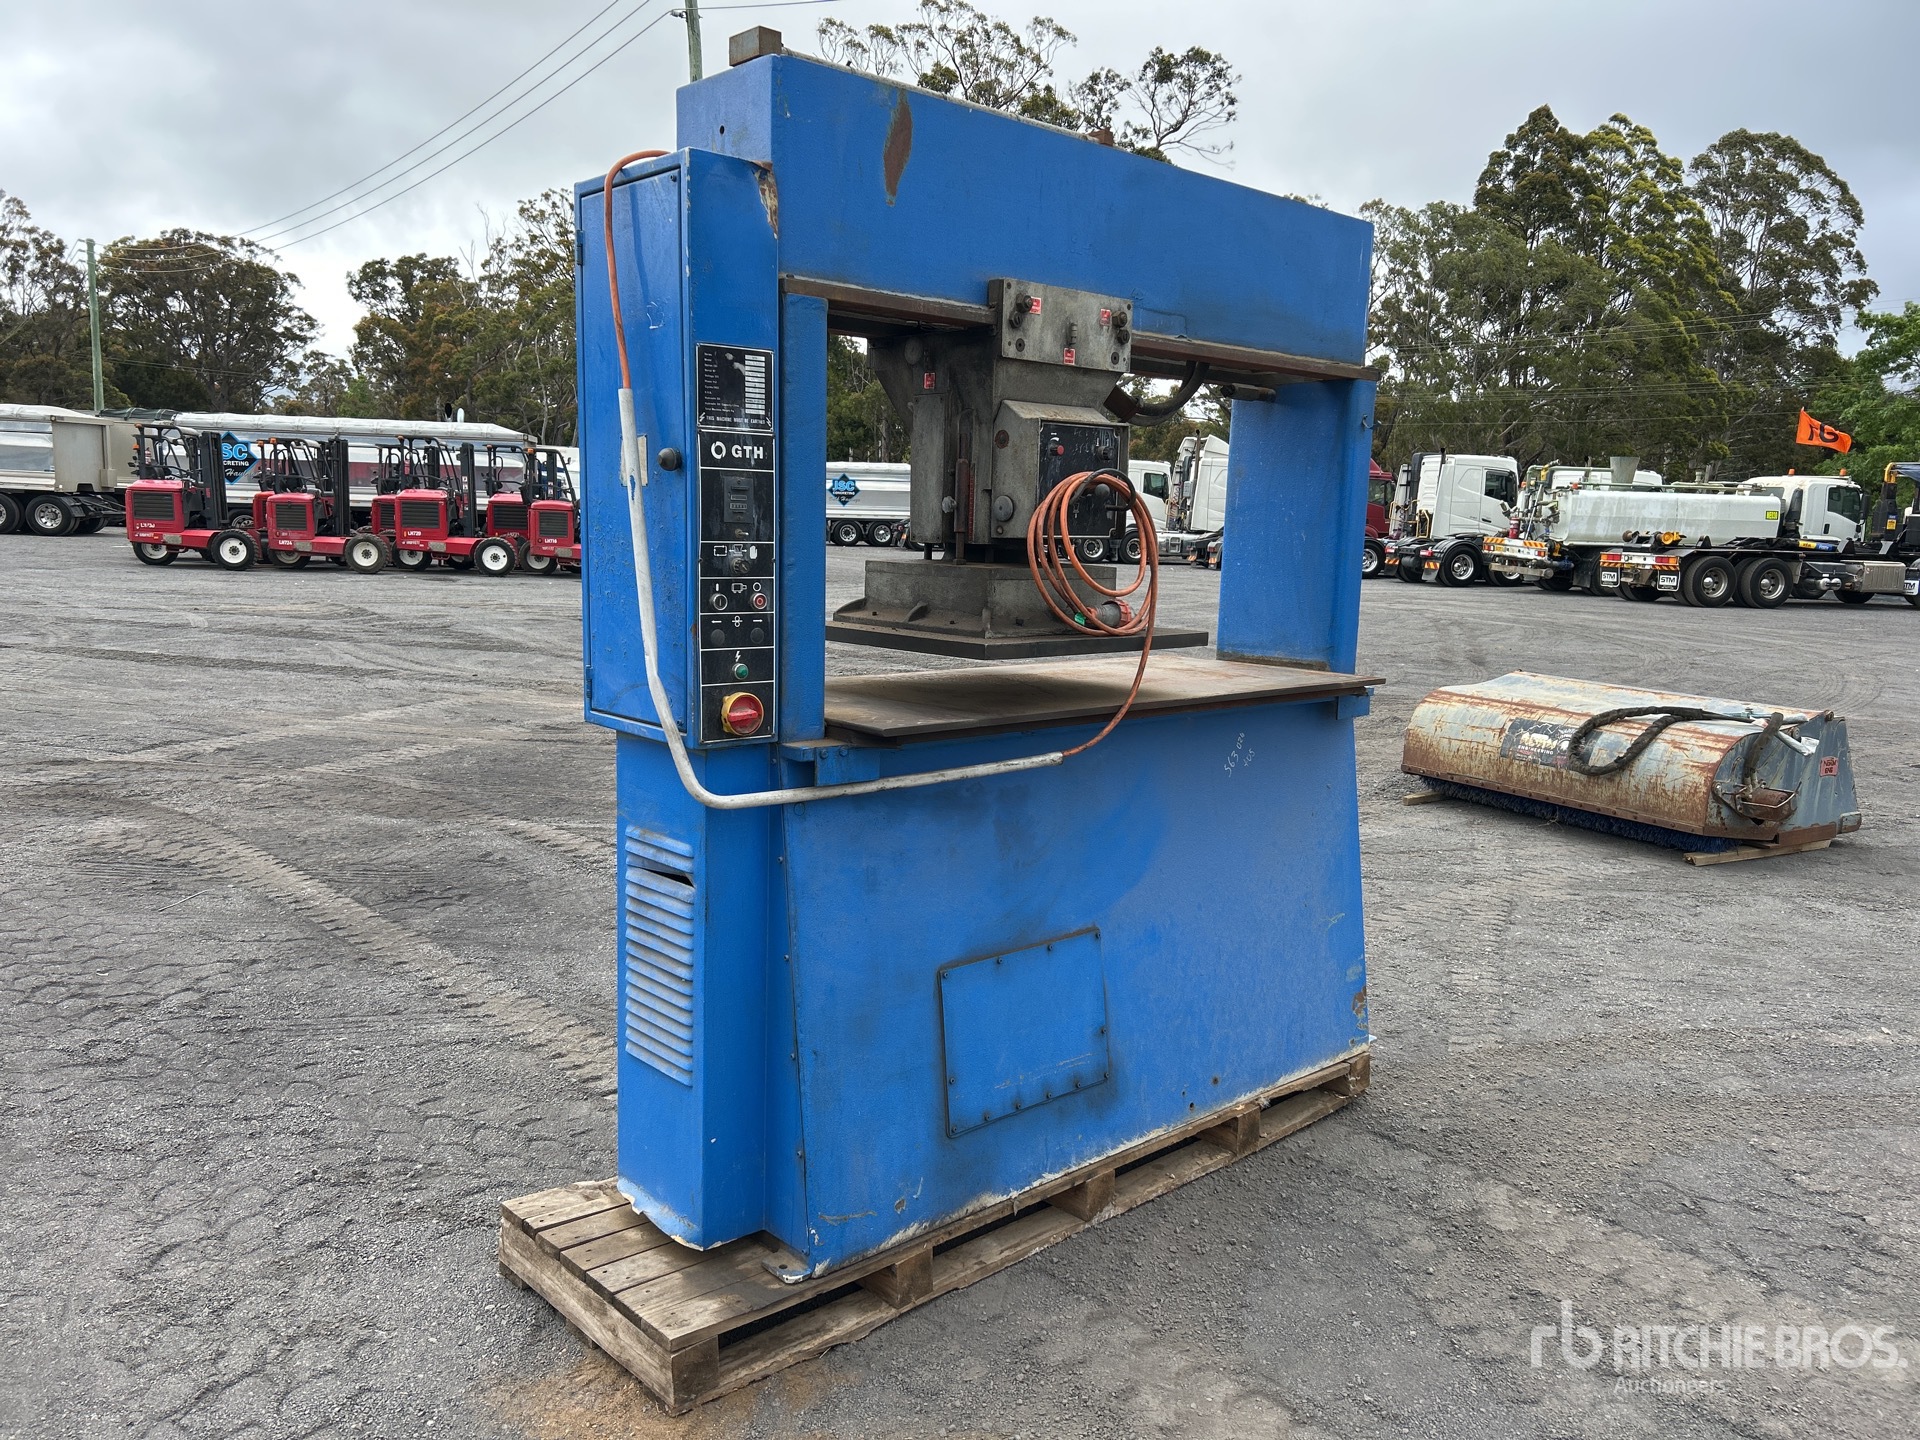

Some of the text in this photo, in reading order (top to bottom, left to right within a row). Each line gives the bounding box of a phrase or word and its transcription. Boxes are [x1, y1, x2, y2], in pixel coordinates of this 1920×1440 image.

[221, 442, 248, 460] SC
[731, 444, 764, 459] GTH
[832, 480, 855, 492] JSC
